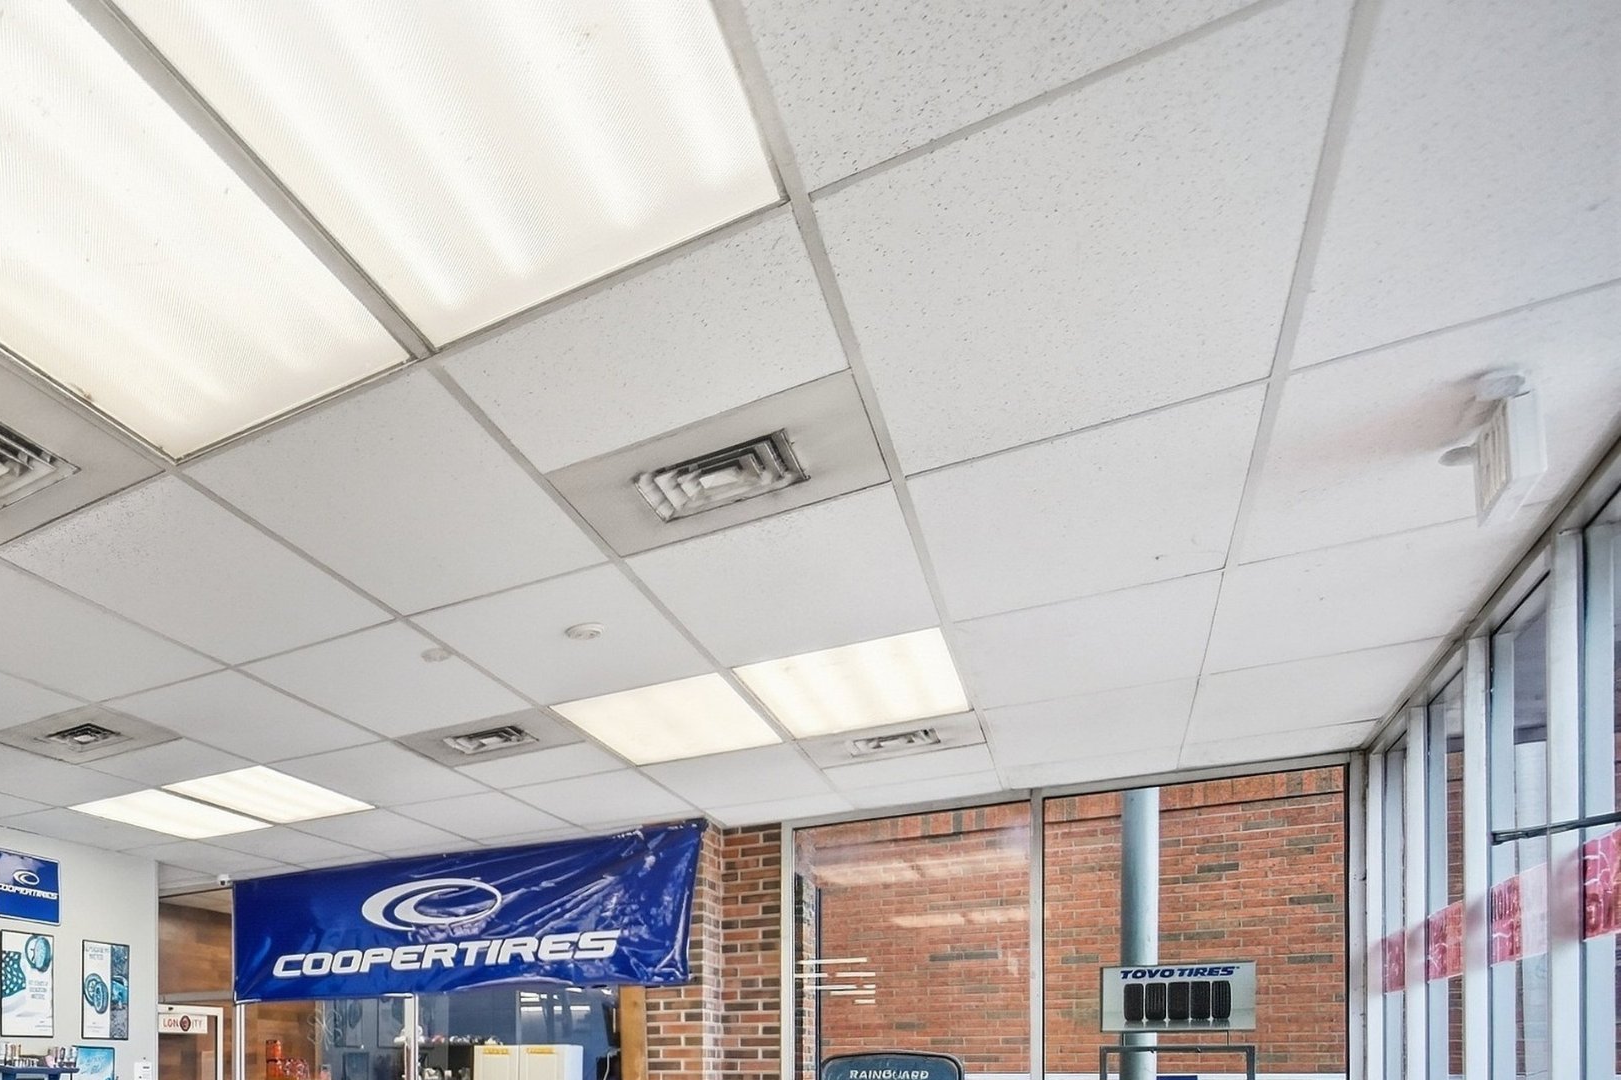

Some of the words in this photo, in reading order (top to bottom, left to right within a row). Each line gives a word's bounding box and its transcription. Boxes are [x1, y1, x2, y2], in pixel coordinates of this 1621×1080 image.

[272, 929, 622, 978] COOPERTIRES
[1179, 965, 1236, 977] TIRES
[849, 1069, 930, 1080] RAINGUARD
